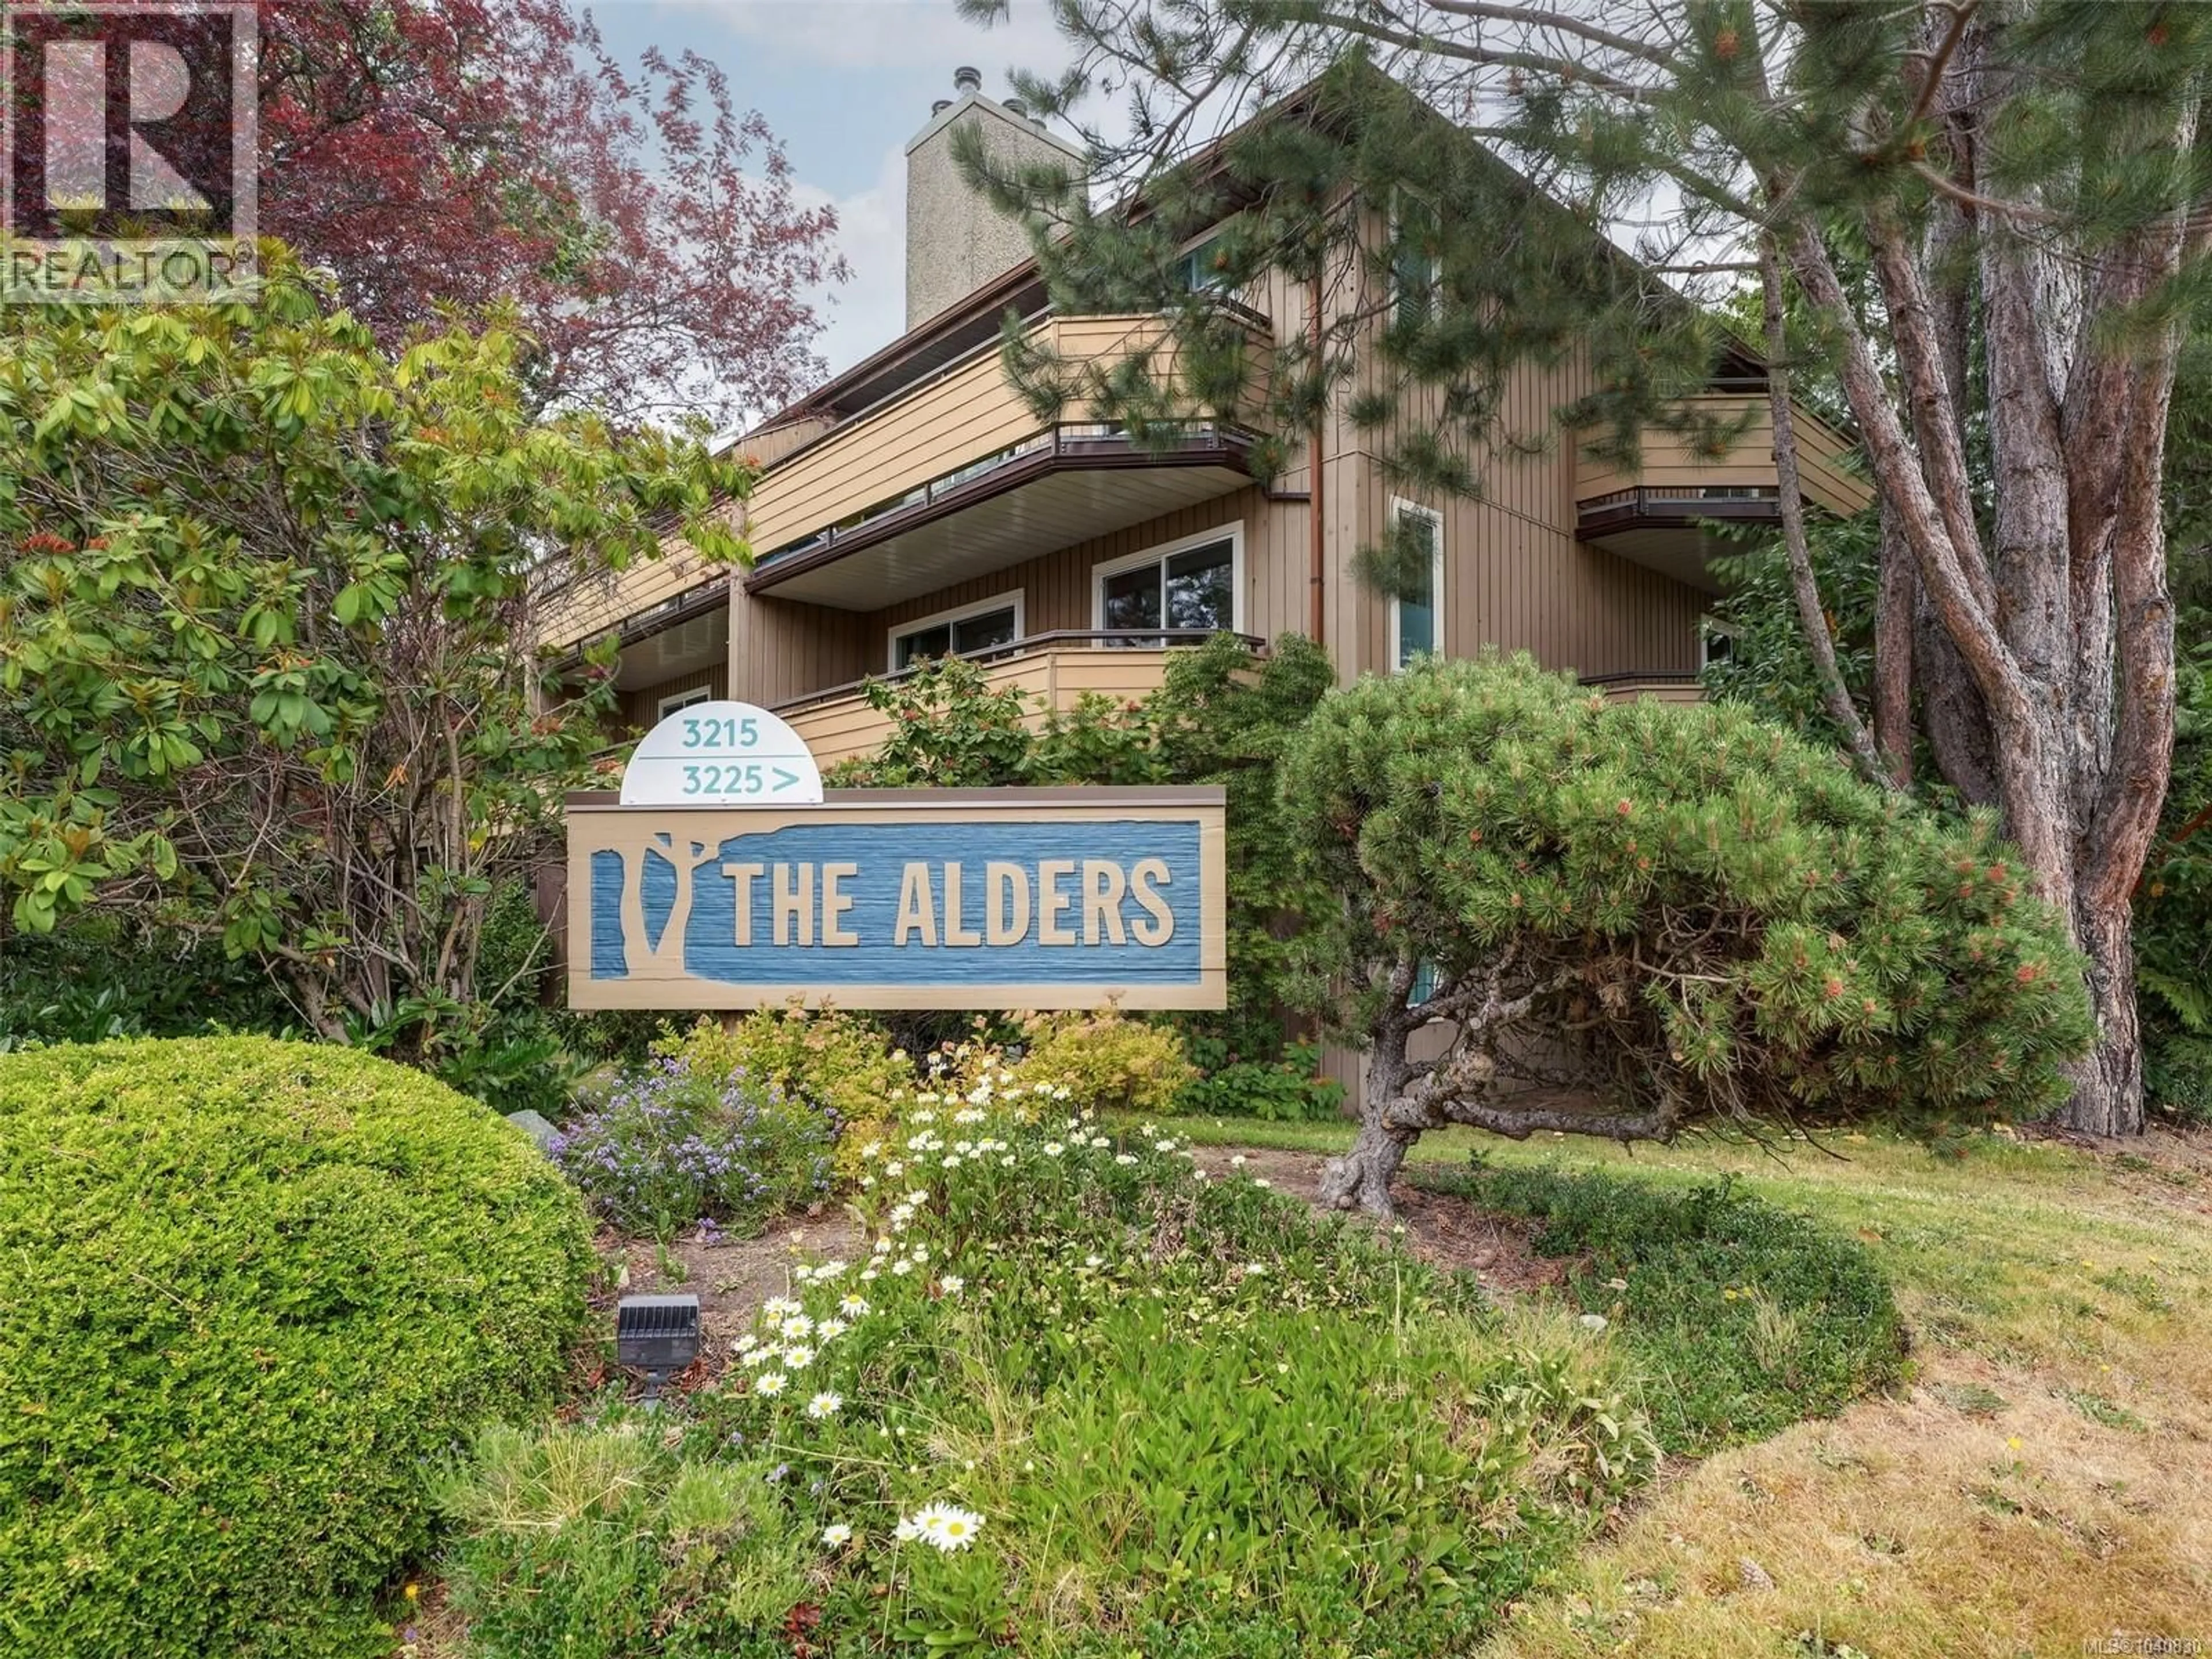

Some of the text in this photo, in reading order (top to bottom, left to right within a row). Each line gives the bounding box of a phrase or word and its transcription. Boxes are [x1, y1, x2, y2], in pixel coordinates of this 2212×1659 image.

[682, 719, 759, 748] 3215
[682, 766, 763, 794] 3225
[722, 858, 1175, 947] THE ALDERS
